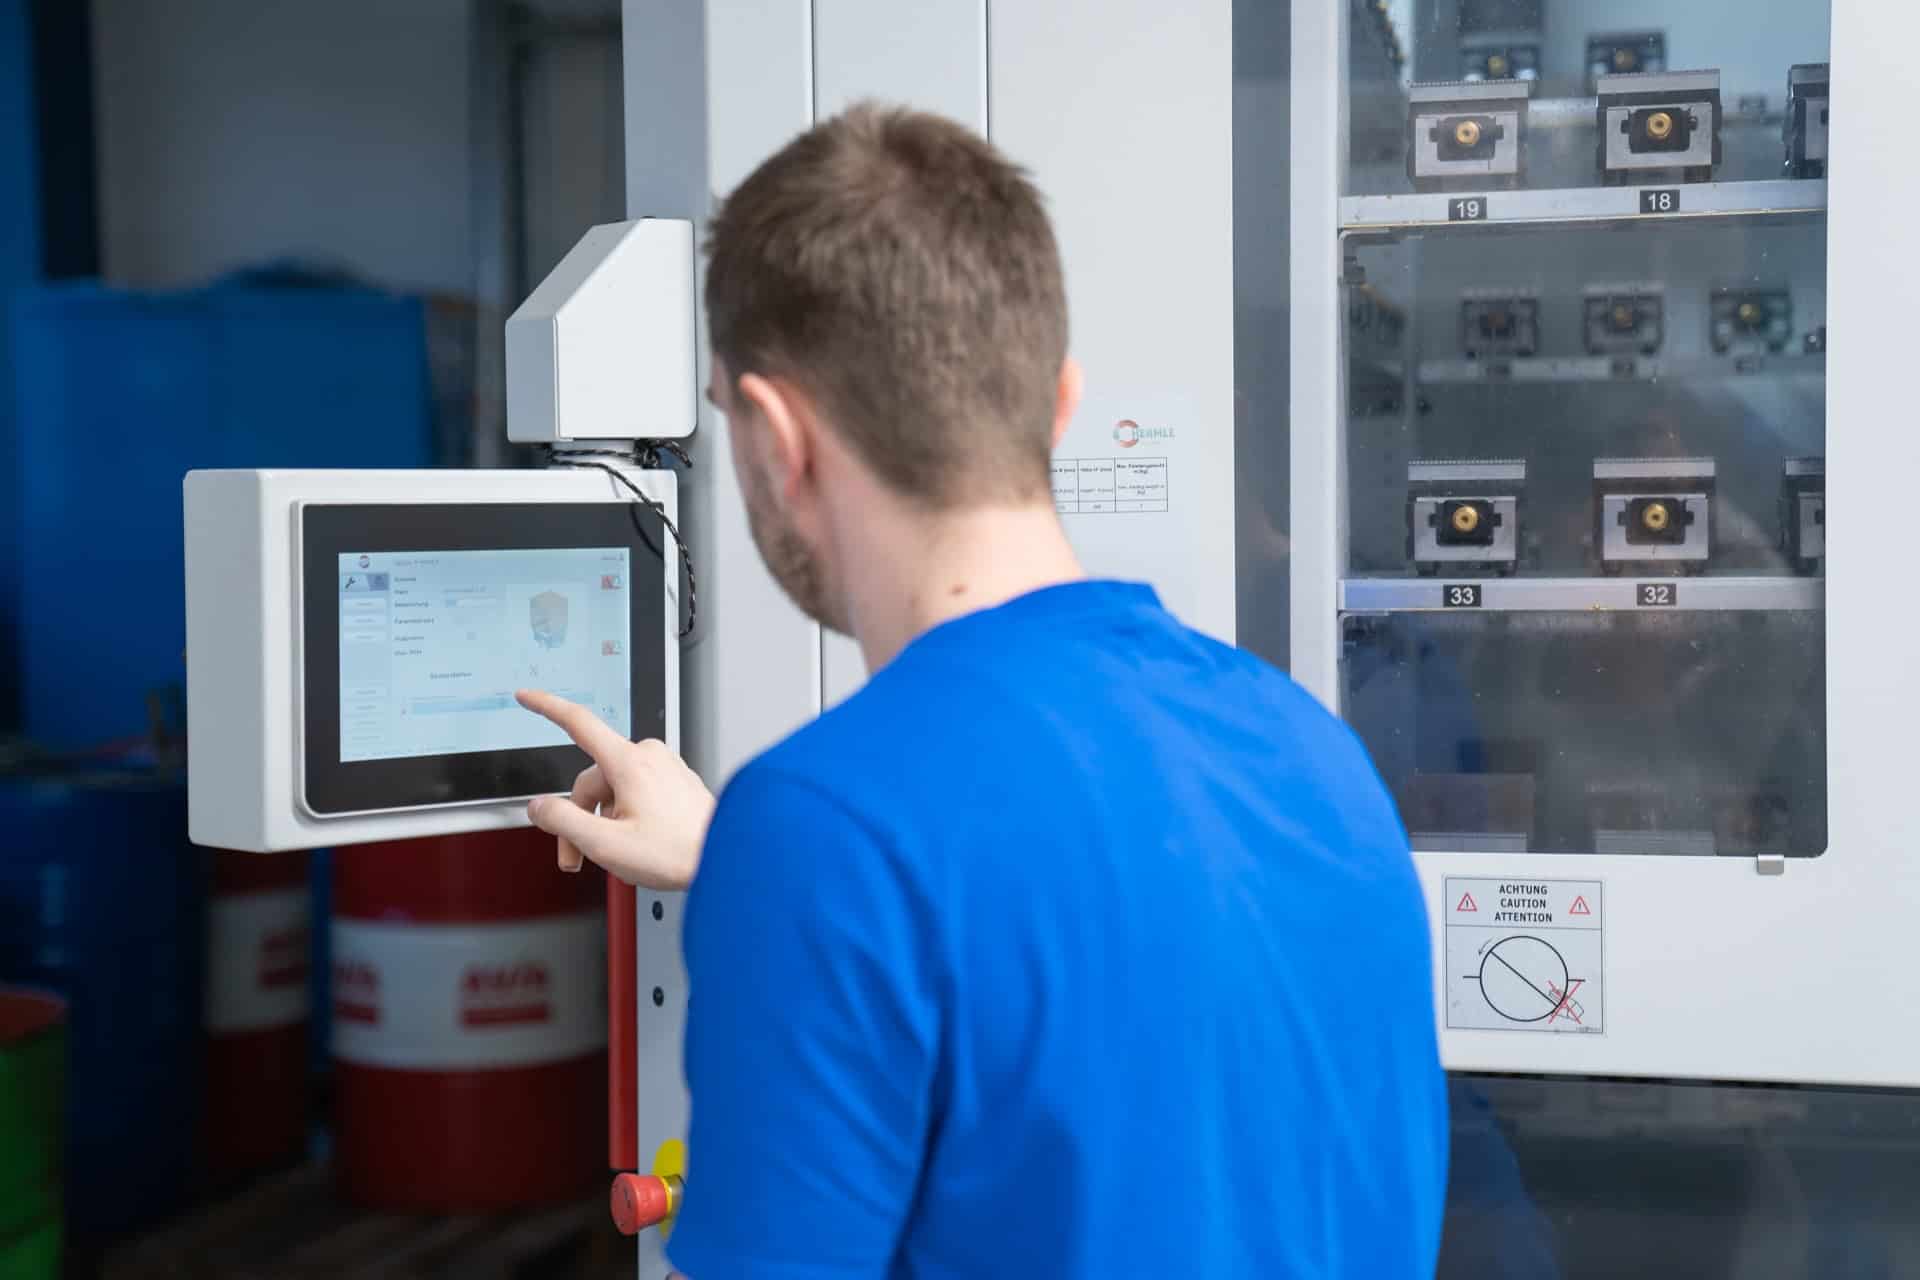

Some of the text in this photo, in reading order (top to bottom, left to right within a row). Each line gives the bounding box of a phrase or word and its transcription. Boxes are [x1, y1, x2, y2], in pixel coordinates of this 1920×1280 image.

[1456, 200, 1480, 219] 19
[1648, 192, 1672, 211] 18
[1450, 587, 1474, 605] 33
[1644, 586, 1669, 604] 32
[1499, 884, 1548, 895] ACHTUNG
[1500, 898, 1547, 909] CAUTION
[1494, 911, 1553, 923] ATTENTION
